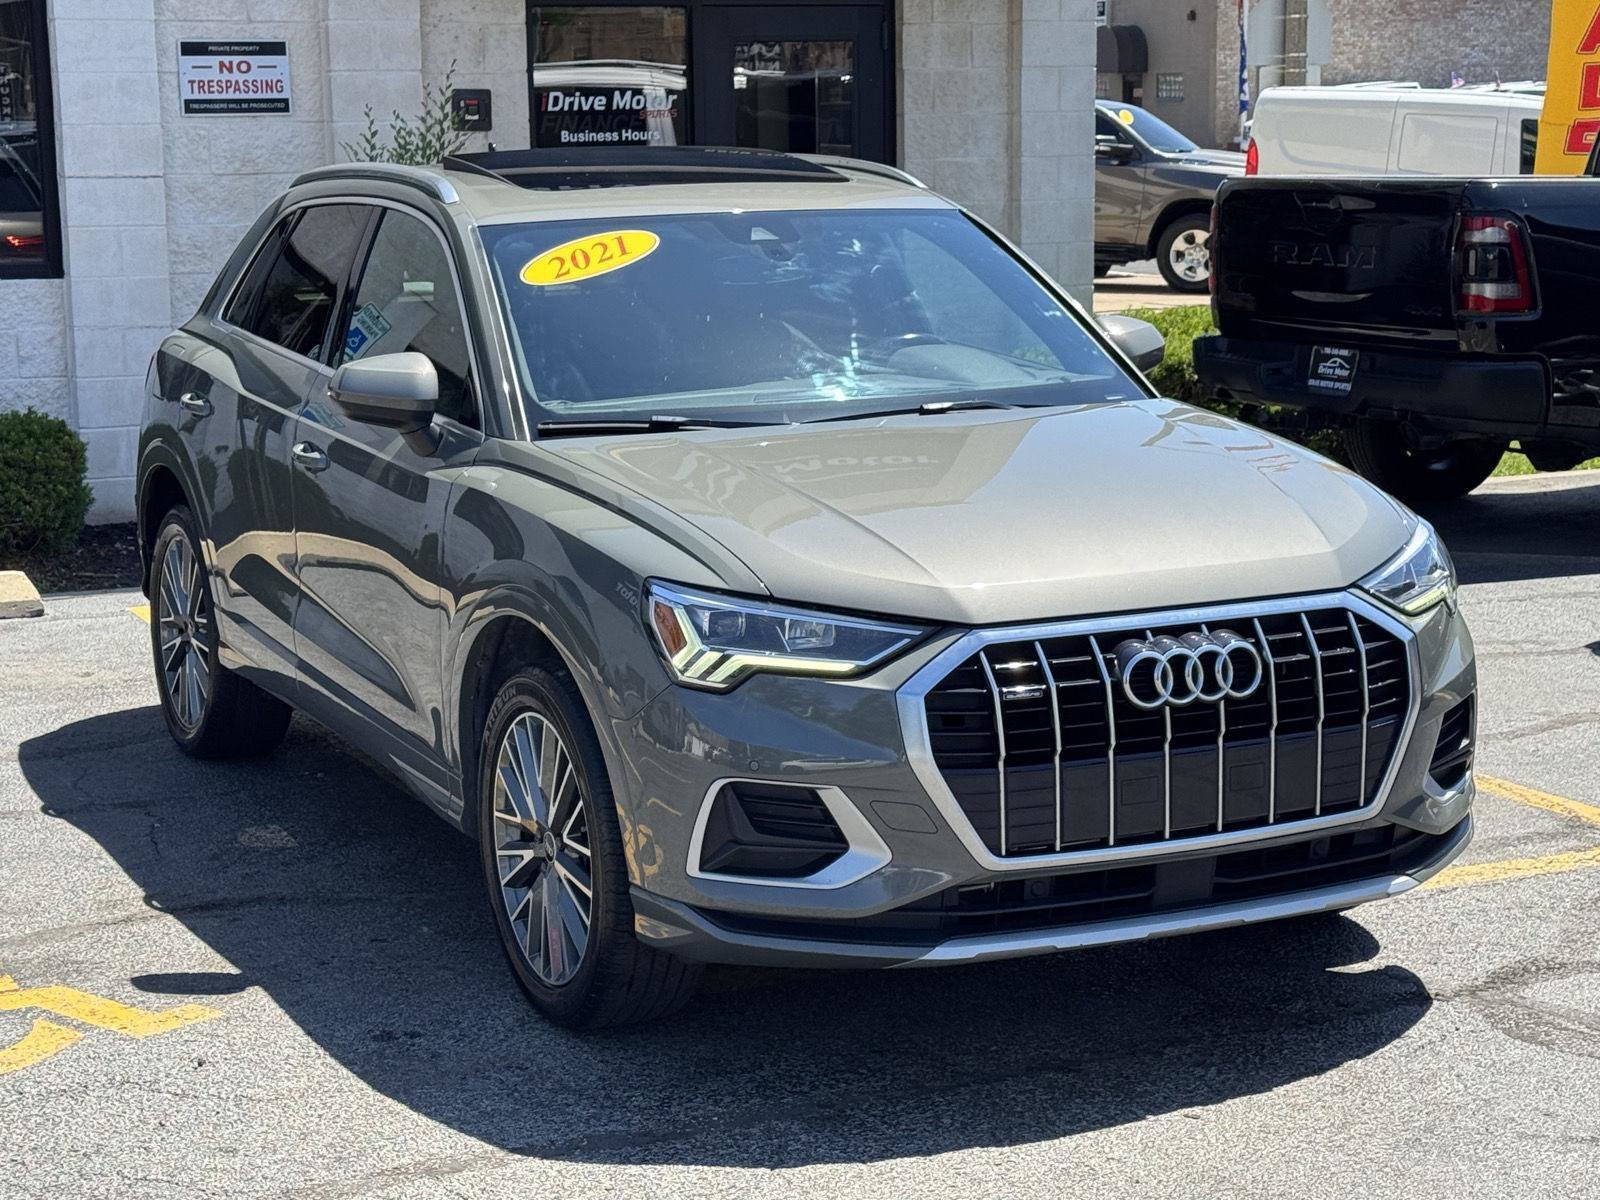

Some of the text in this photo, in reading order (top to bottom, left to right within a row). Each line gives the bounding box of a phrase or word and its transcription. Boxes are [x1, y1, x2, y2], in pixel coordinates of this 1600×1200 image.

[218, 60, 252, 74] NO
[187, 79, 284, 95] TRESPASSING
[612, 90, 678, 110] Motor
[639, 108, 678, 120] SPORTS
[560, 128, 661, 143] Business Hours
[548, 235, 632, 280] 2021
[1271, 242, 1376, 269] RAM
